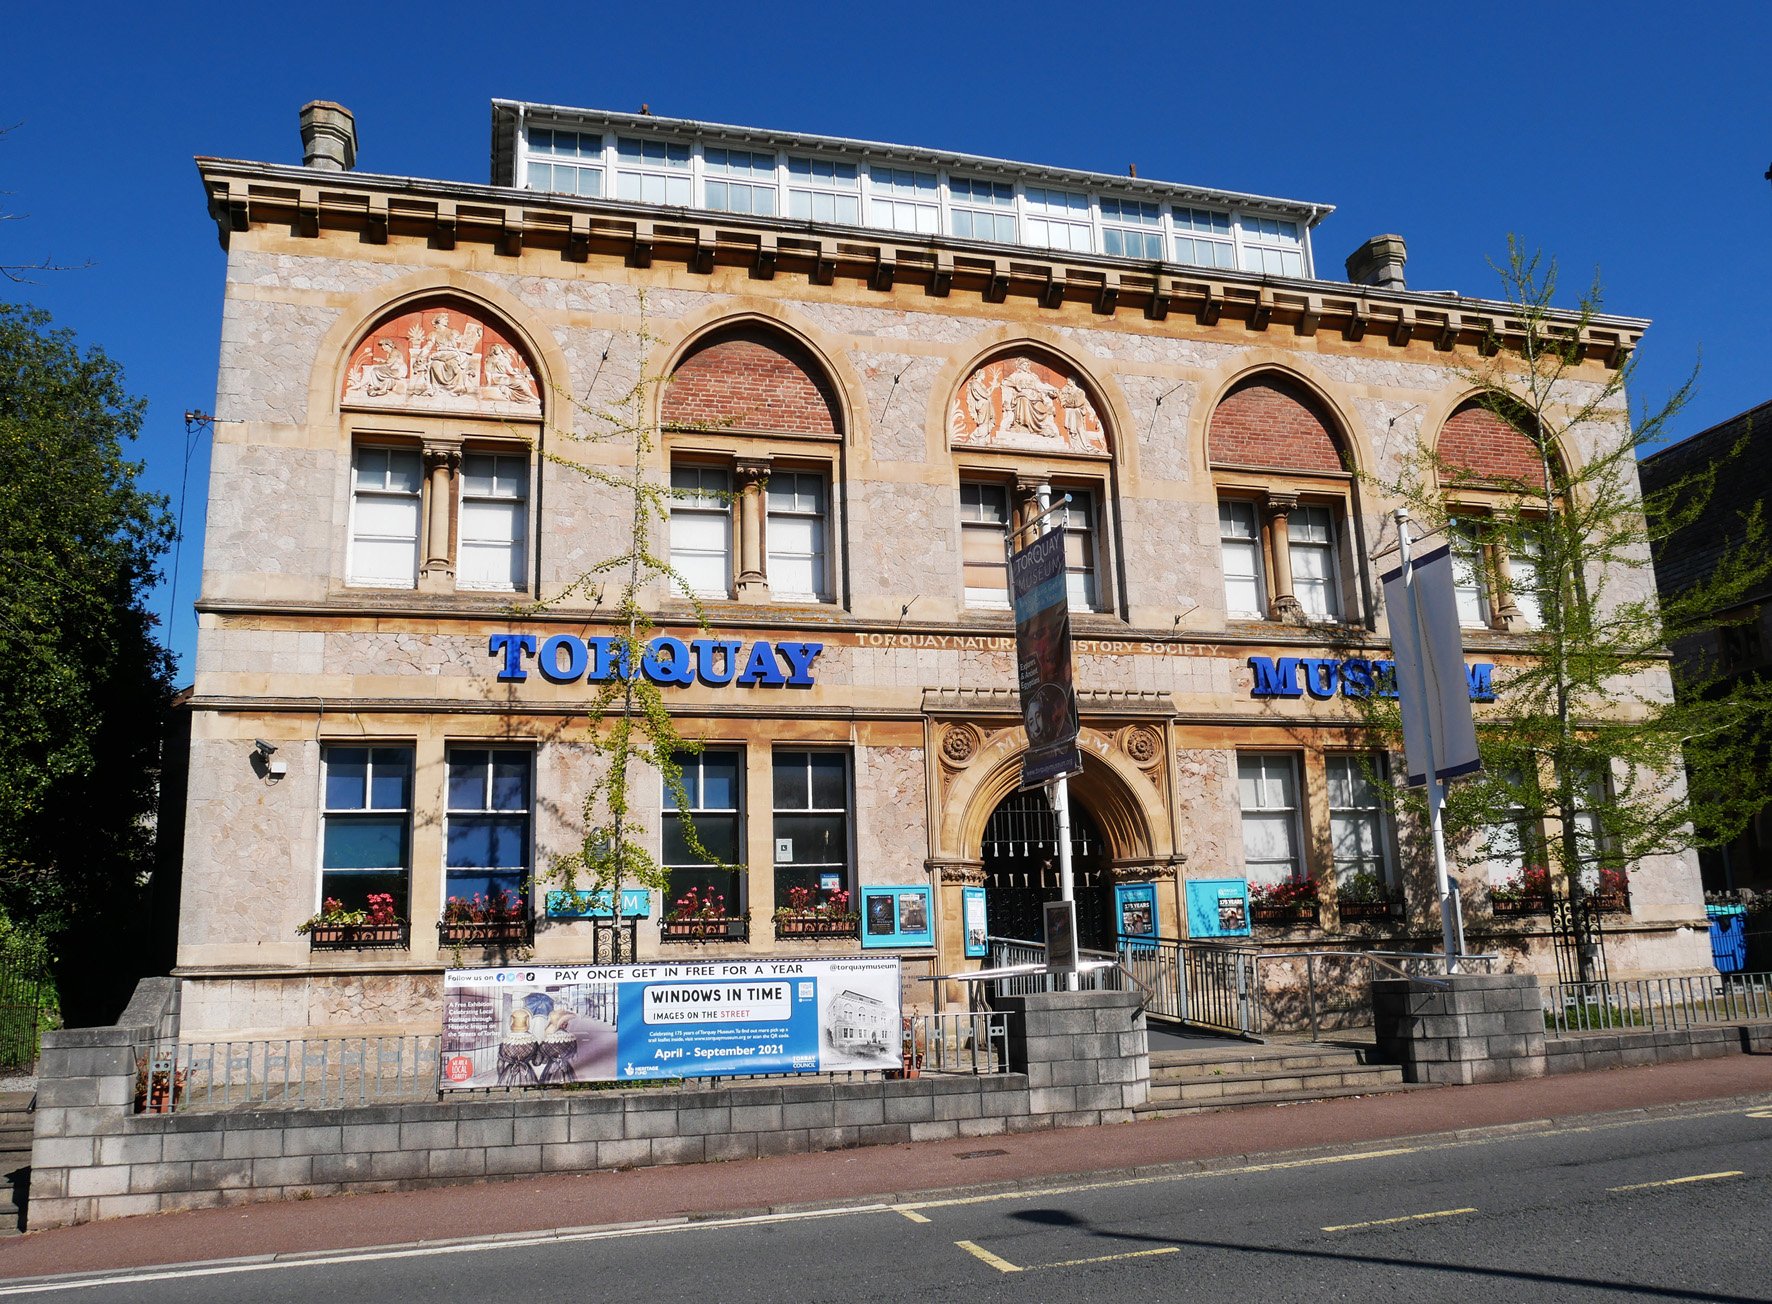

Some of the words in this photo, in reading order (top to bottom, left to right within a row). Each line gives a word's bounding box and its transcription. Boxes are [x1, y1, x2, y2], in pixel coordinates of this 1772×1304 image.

[1016, 533, 1060, 572] TORQUAY
[1018, 556, 1061, 590] MUSEUM
[855, 633, 950, 647] TORQUAY
[953, 636, 1017, 650] NATUR
[1072, 640, 1135, 652] ISTORY
[489, 634, 823, 687] TORQUAY
[1249, 656, 1498, 701] MUSEM
[555, 971, 579, 980] PAY
[587, 970, 624, 979] ONCE
[632, 968, 657, 978] GET
[664, 967, 678, 976] IN
[686, 966, 715, 976] FREE
[722, 966, 747, 975] FOR
[754, 965, 764, 974] A
[771, 964, 803, 974] YEAR
[652, 989, 721, 1003] WINDOWS
[727, 989, 741, 1000] IN
[747, 987, 782, 1000] TIME
[653, 1011, 684, 1020] IMAGES
[654, 1048, 682, 1060] April
[694, 1046, 755, 1059] September
[758, 1044, 783, 1054] 2021
